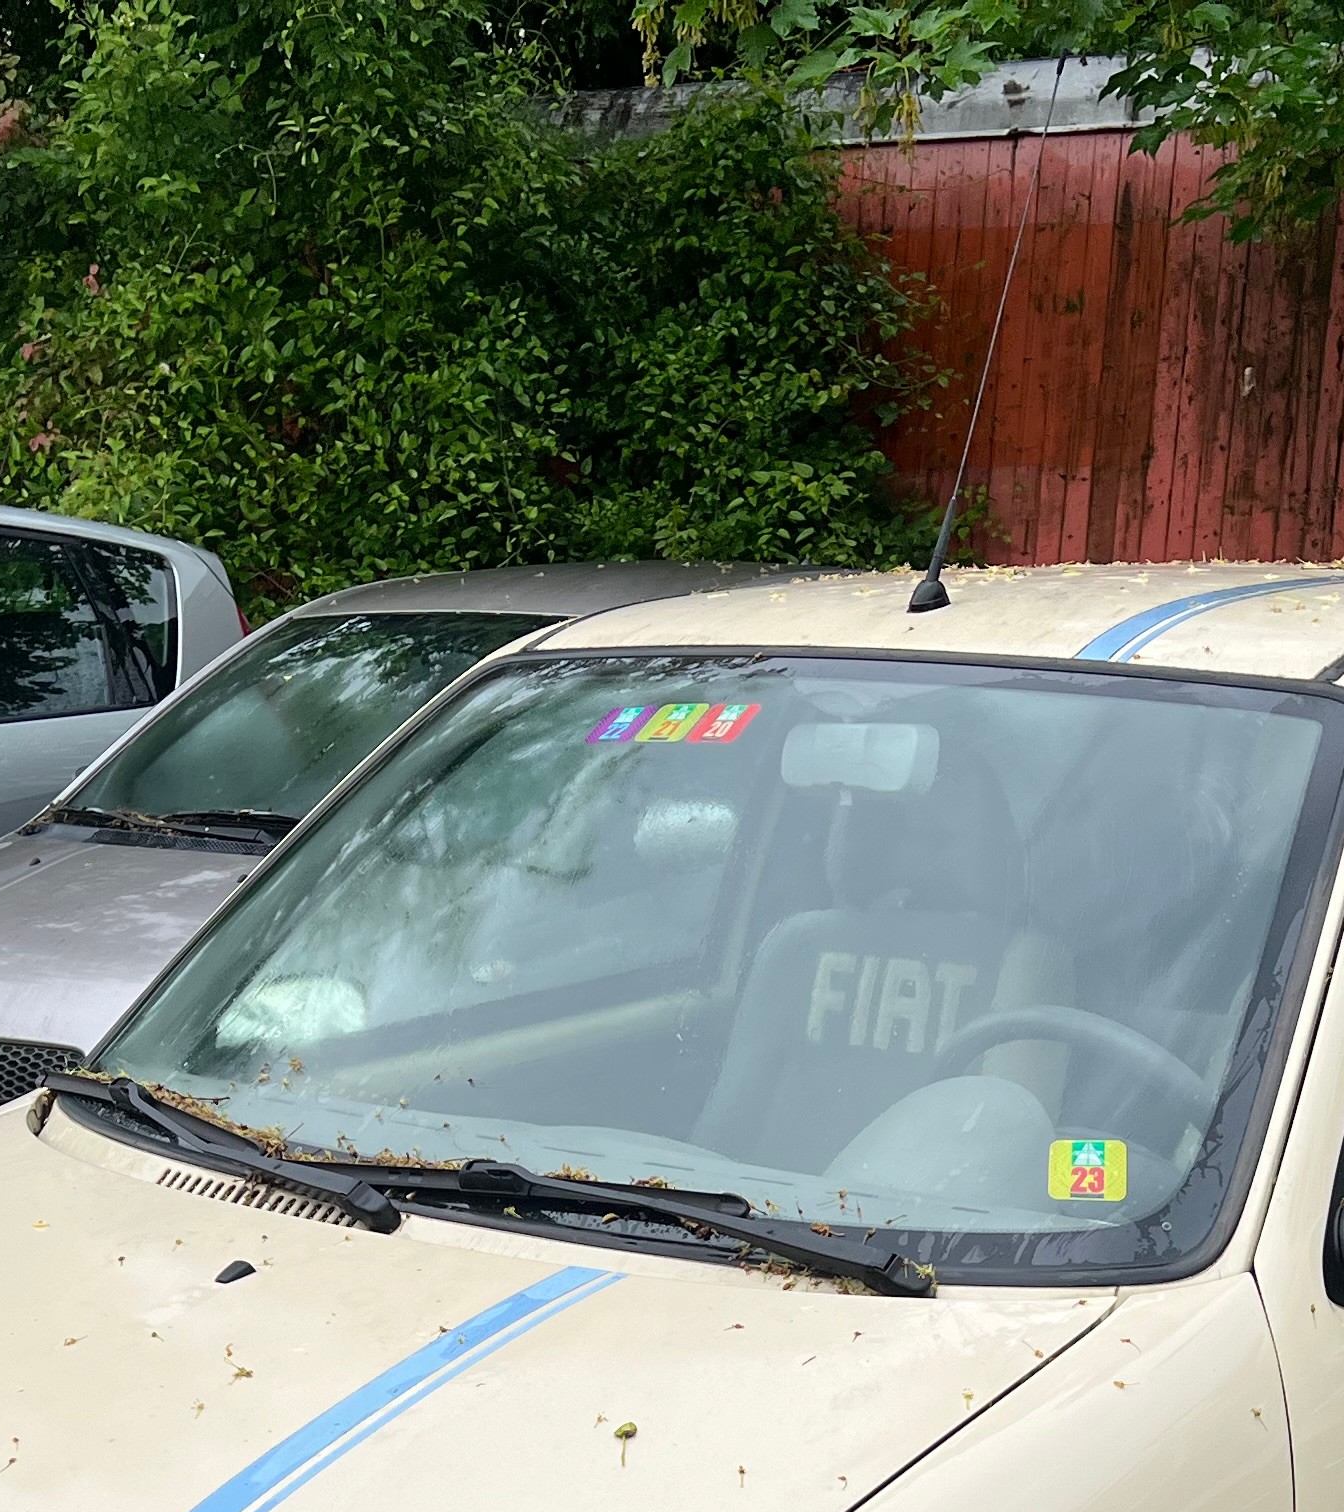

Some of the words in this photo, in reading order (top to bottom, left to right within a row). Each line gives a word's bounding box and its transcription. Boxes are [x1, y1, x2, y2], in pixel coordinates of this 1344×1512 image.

[598, 722, 631, 740] 22
[653, 721, 682, 737] 21
[702, 721, 734, 738] 20
[806, 951, 977, 1056] FIAT
[1070, 1166, 1104, 1194] 23
